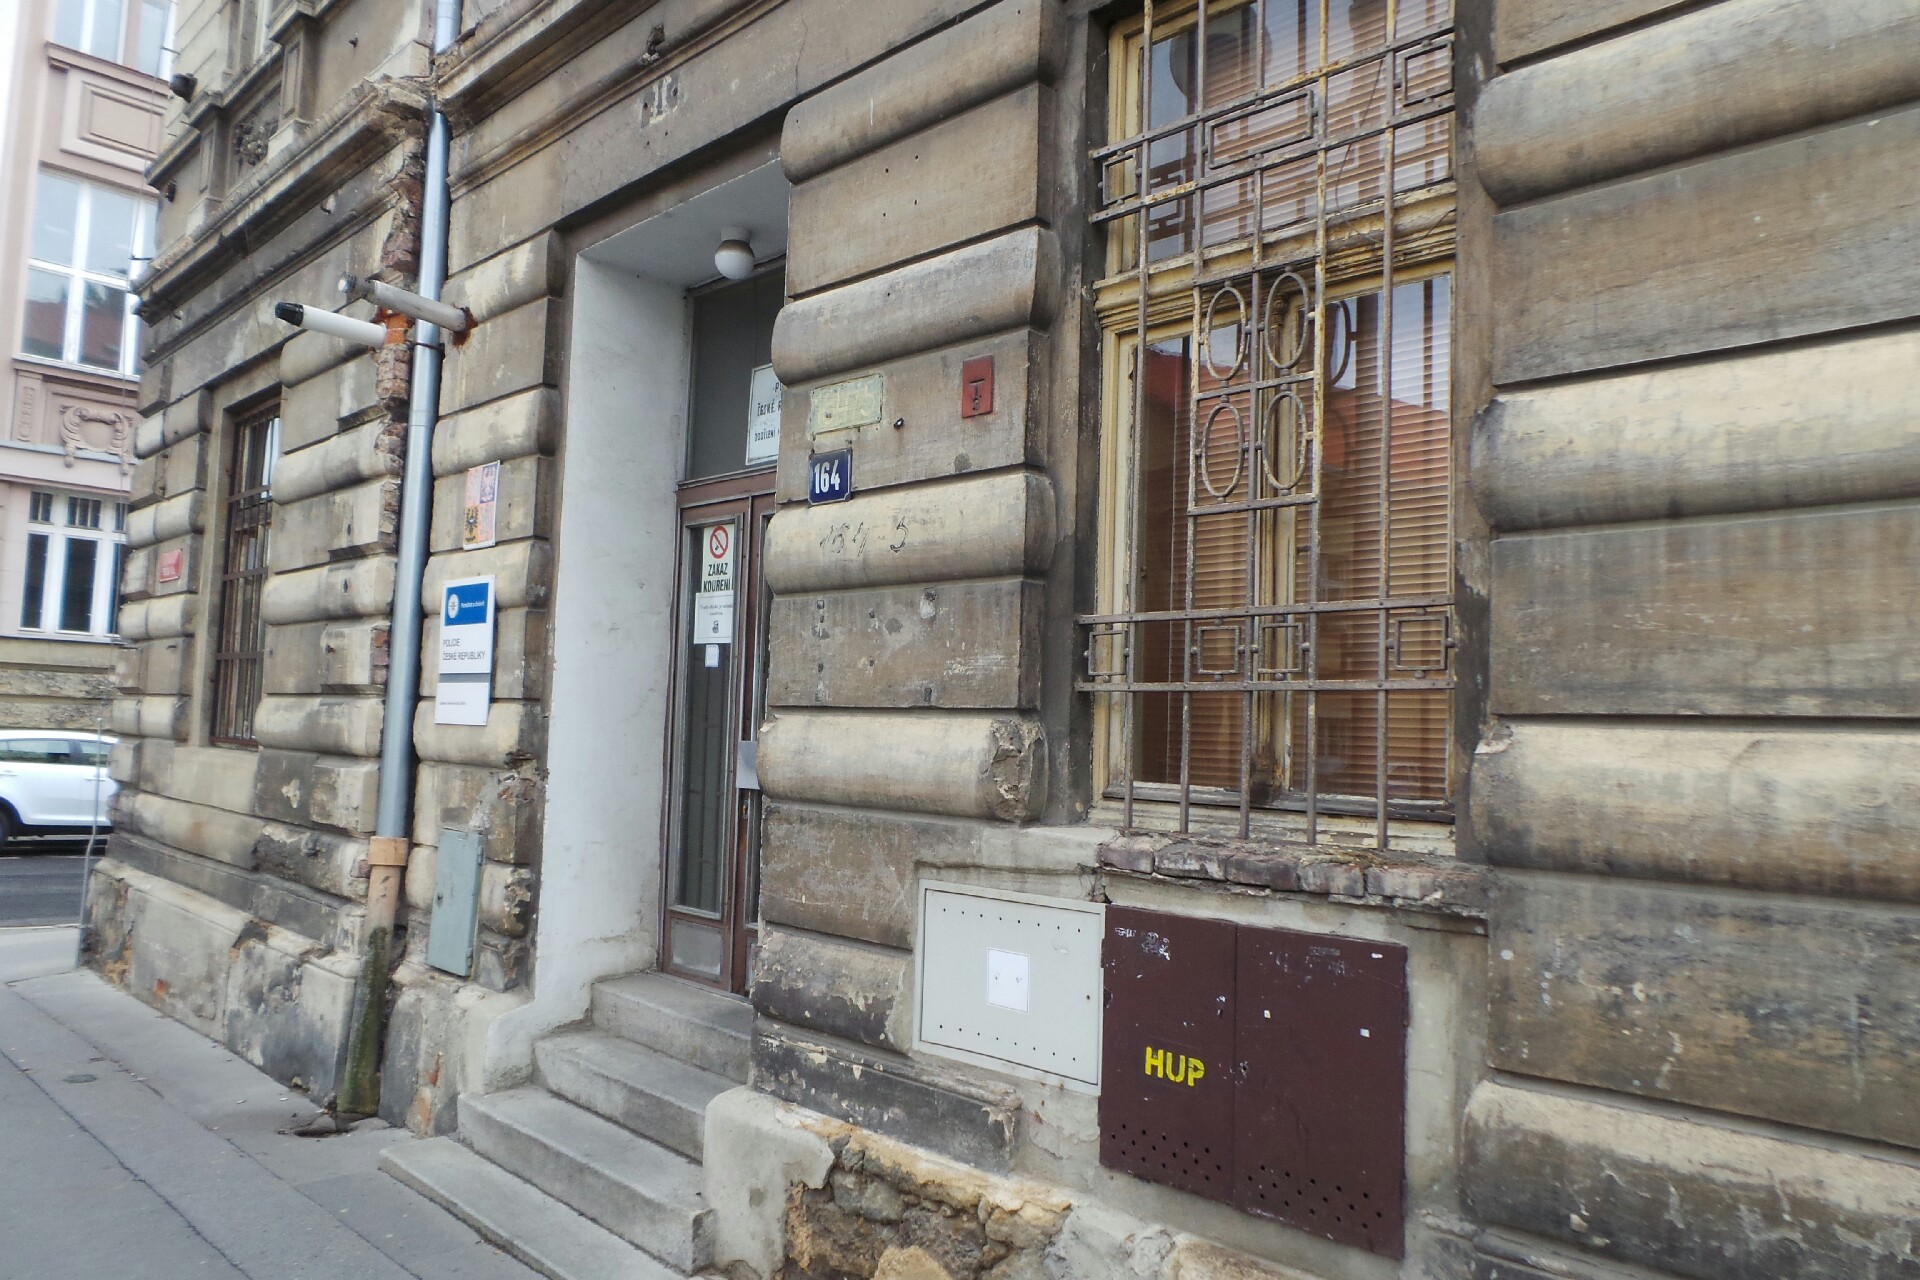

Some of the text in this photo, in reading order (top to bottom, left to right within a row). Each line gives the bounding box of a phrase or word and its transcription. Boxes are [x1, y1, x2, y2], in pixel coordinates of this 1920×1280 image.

[814, 459, 841, 494] 164
[442, 638, 461, 647] POLICIE
[458, 650, 486, 660] REPUBLIKY
[1145, 1046, 1206, 1087] HUP
